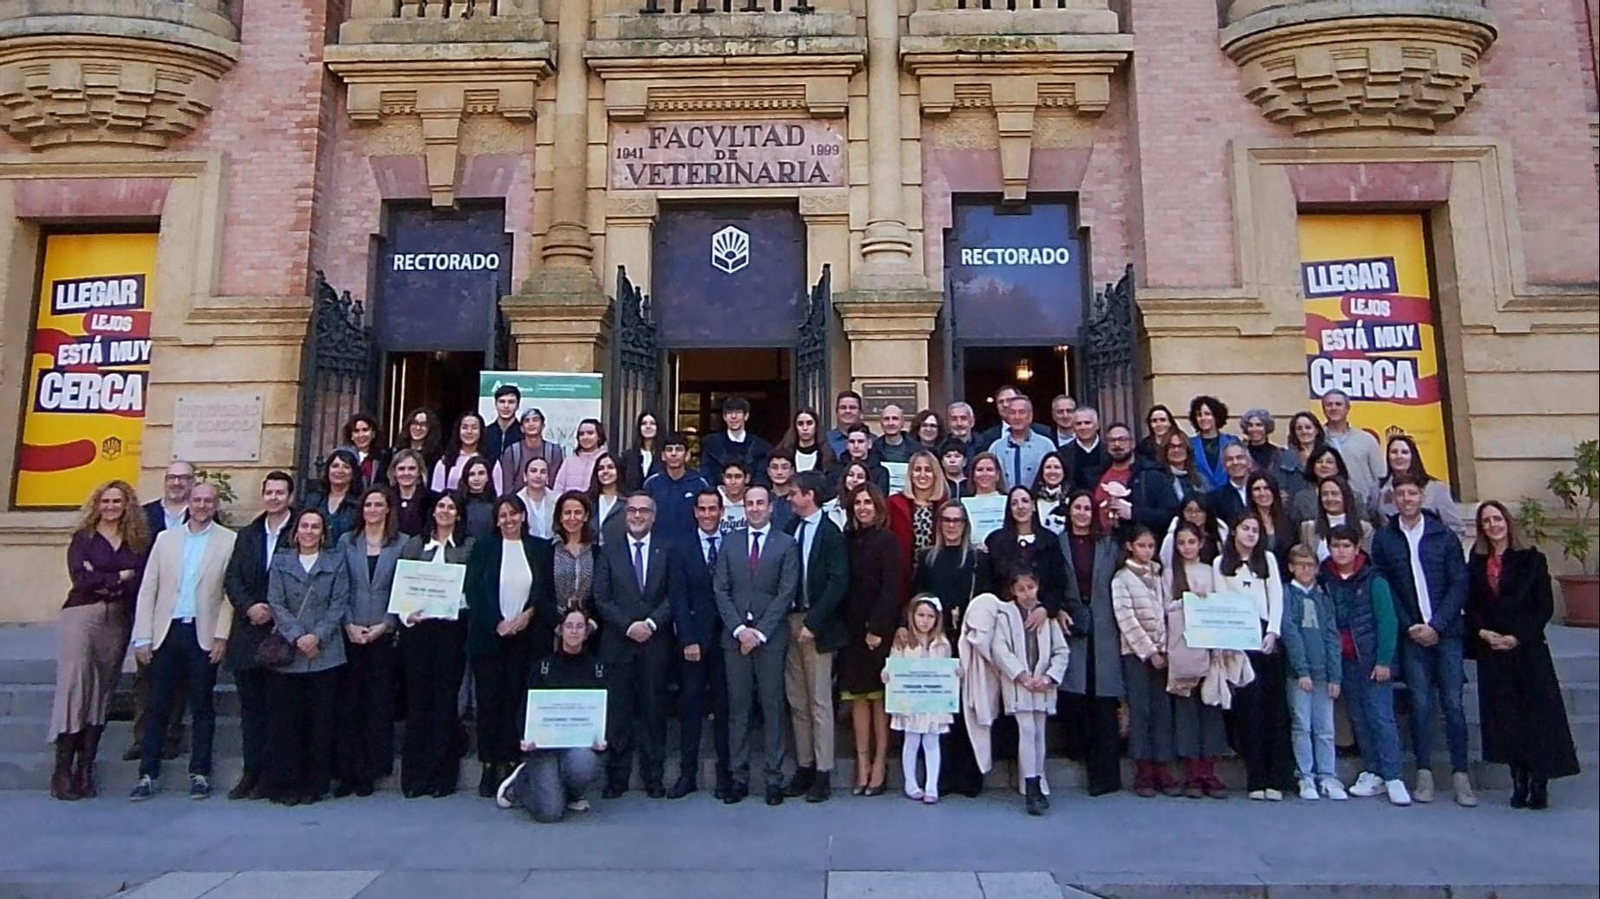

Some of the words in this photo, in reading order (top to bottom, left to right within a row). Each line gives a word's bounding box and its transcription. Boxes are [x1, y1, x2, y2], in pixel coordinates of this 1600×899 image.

[648, 124, 807, 150] FACVLTAD
[615, 146, 644, 160] 1941
[715, 150, 738, 160] DE
[625, 161, 829, 186] VETERINARIA
[393, 252, 500, 272] RECTORADO
[961, 247, 1070, 266] RECTORADO
[1306, 261, 1391, 294] LLEGAR
[56, 278, 137, 310] LLEGAR
[1350, 297, 1392, 317] LEJOS
[91, 313, 133, 332] LEJOS
[1321, 320, 1368, 351] ESTÁ
[1373, 323, 1416, 349] MUY
[57, 335, 104, 366] ESTÁ
[110, 339, 152, 363] MUY
[39, 371, 144, 411] CERCA
[1310, 358, 1419, 399] CERCA
